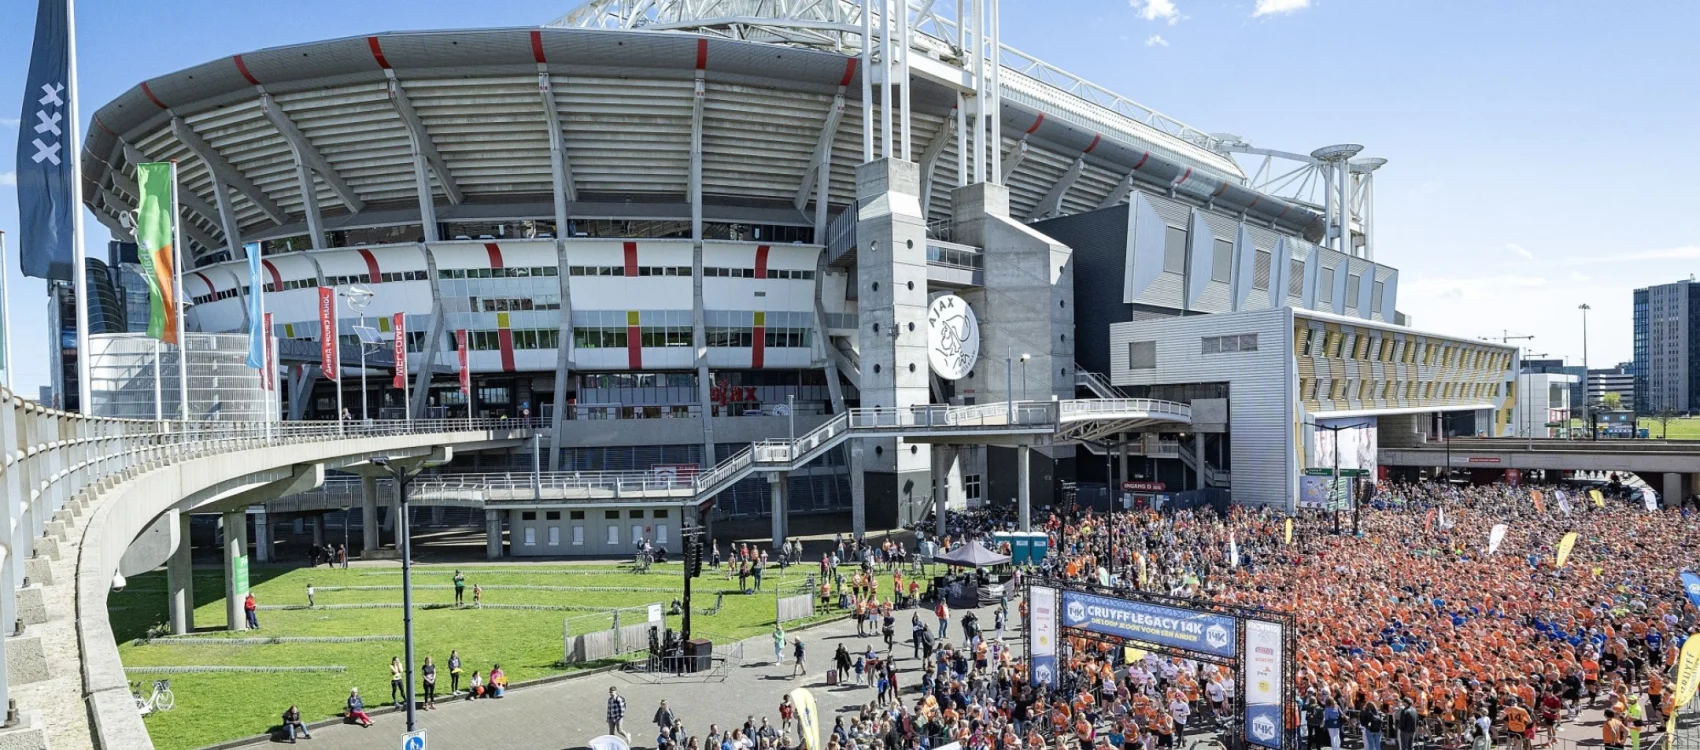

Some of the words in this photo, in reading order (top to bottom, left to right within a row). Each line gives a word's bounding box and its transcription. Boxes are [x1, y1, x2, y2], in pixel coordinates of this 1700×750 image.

[929, 297, 954, 328] AJAX
[1087, 605, 1130, 622] CRUYFF
[1131, 612, 1180, 630] LEGACY
[1180, 621, 1203, 635] 14K
[1141, 626, 1160, 635] VOOR
[1174, 632, 1198, 642] ANDER
[1207, 630, 1226, 643] 14K
[1509, 713, 1521, 721] 14
[1253, 722, 1274, 736] 14K
